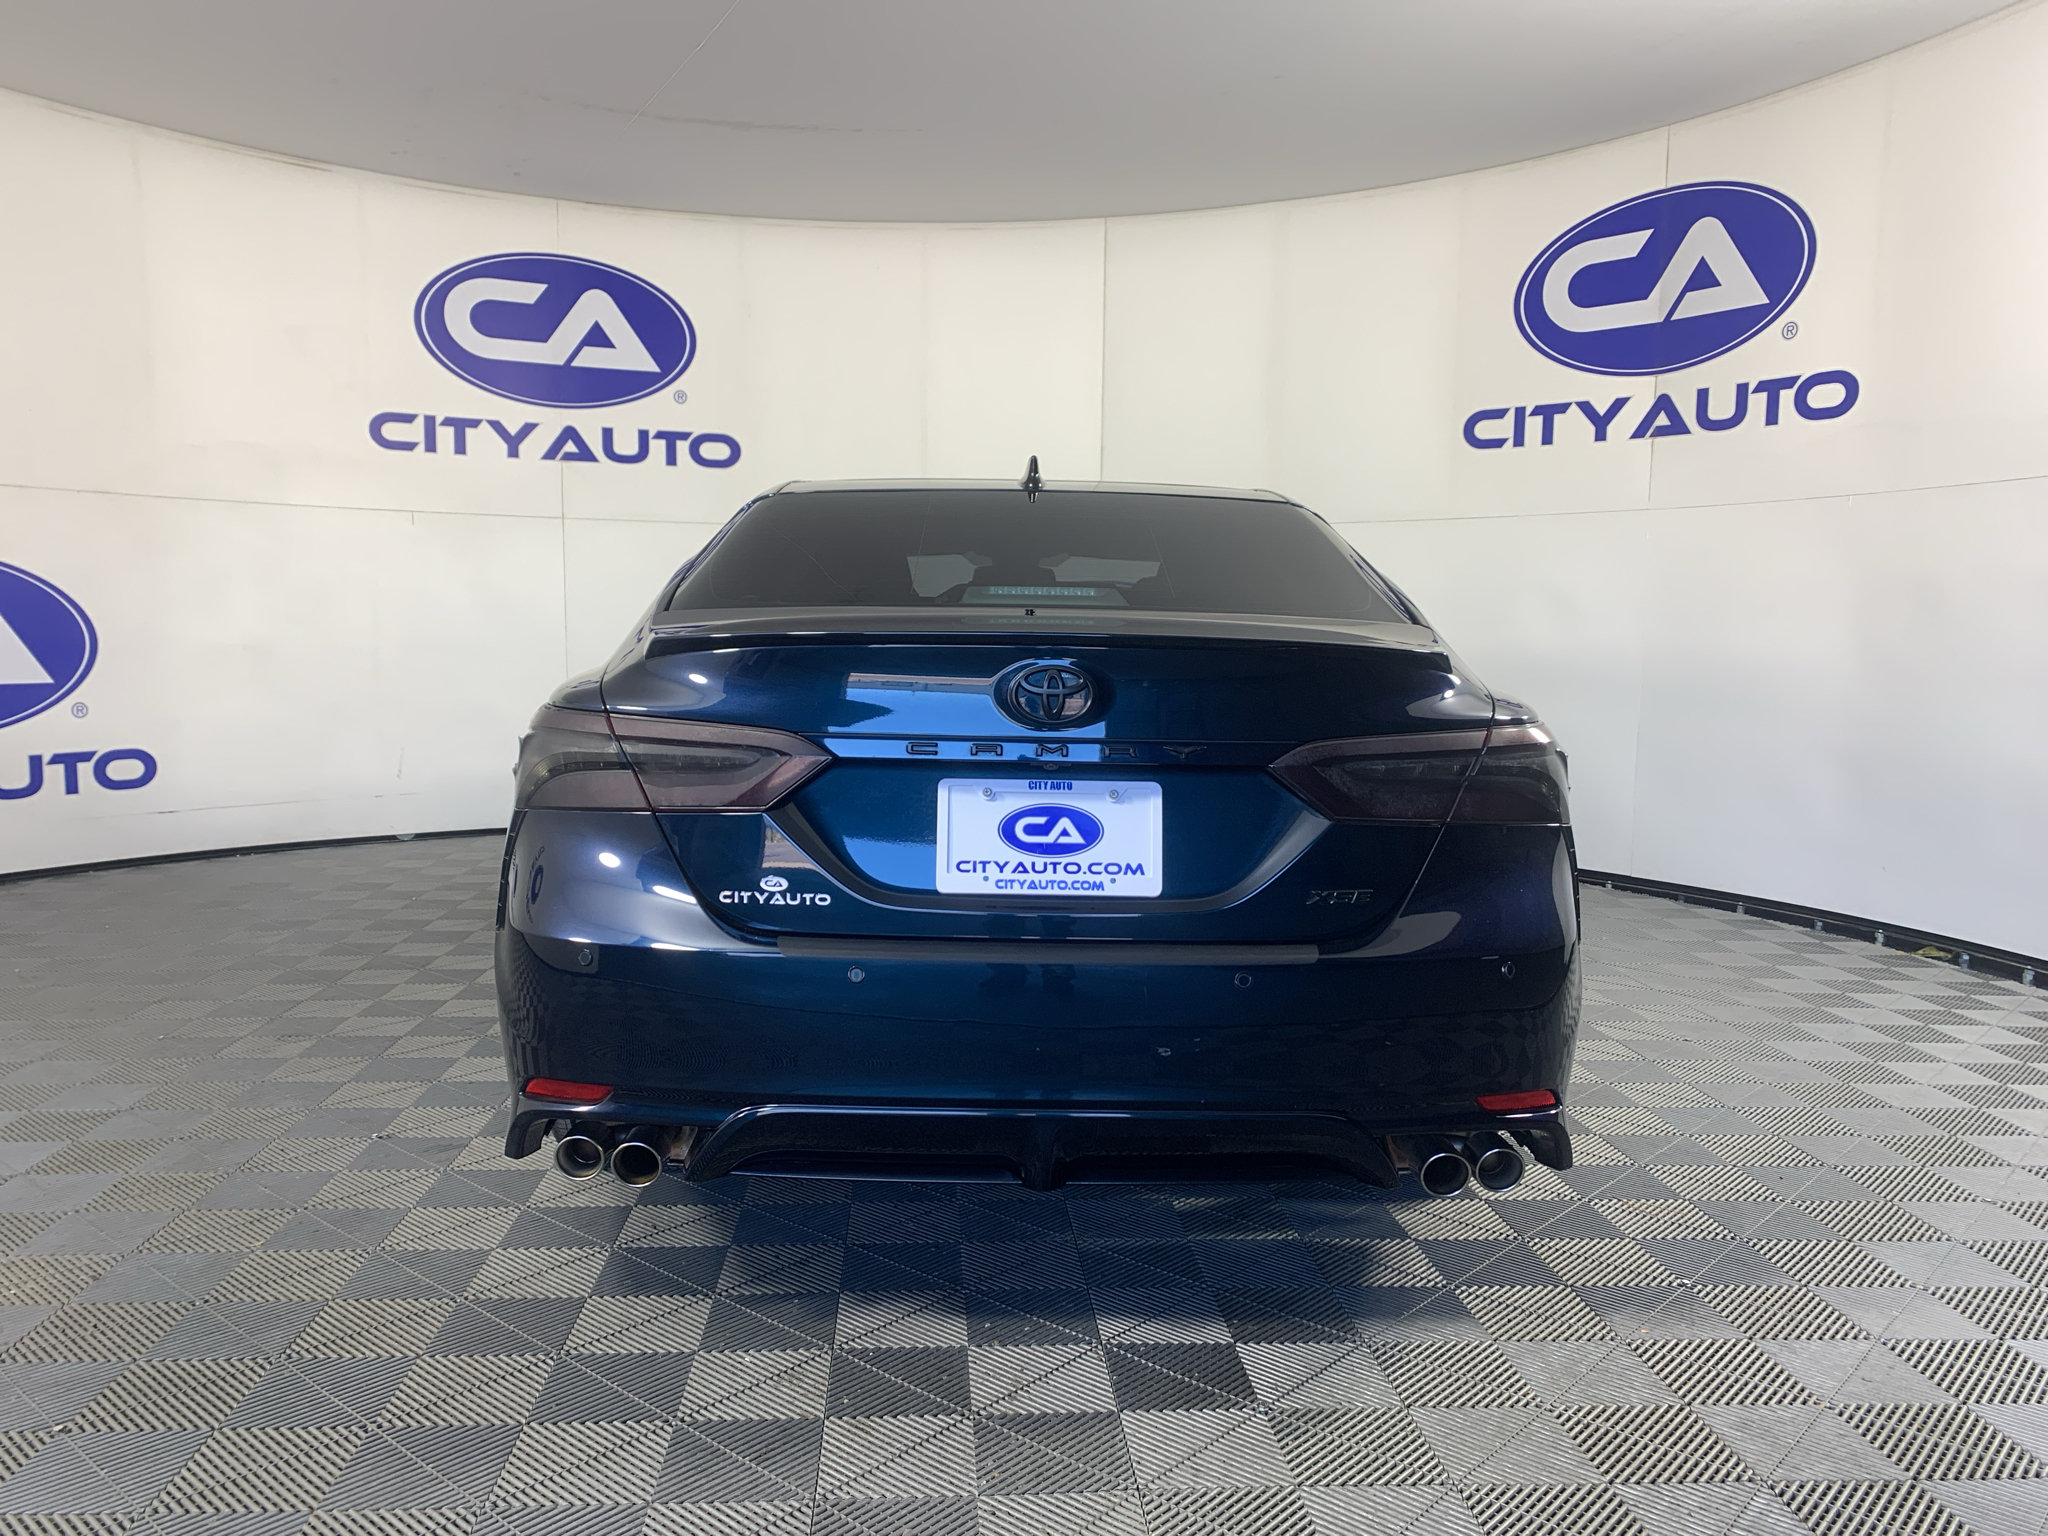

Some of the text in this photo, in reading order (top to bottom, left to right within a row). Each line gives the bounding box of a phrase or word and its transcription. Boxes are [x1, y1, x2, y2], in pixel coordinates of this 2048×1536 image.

[1542, 215, 1771, 333] CA
[444, 277, 662, 373] CA
[905, 741, 1208, 760] CAMRY
[1028, 780, 1073, 791] CITY AUTO
[1014, 816, 1087, 844] CA
[955, 860, 1146, 876] CITYAUTO.COM
[764, 879, 783, 888] CA
[994, 878, 1105, 891] CITYAUTO.COM
